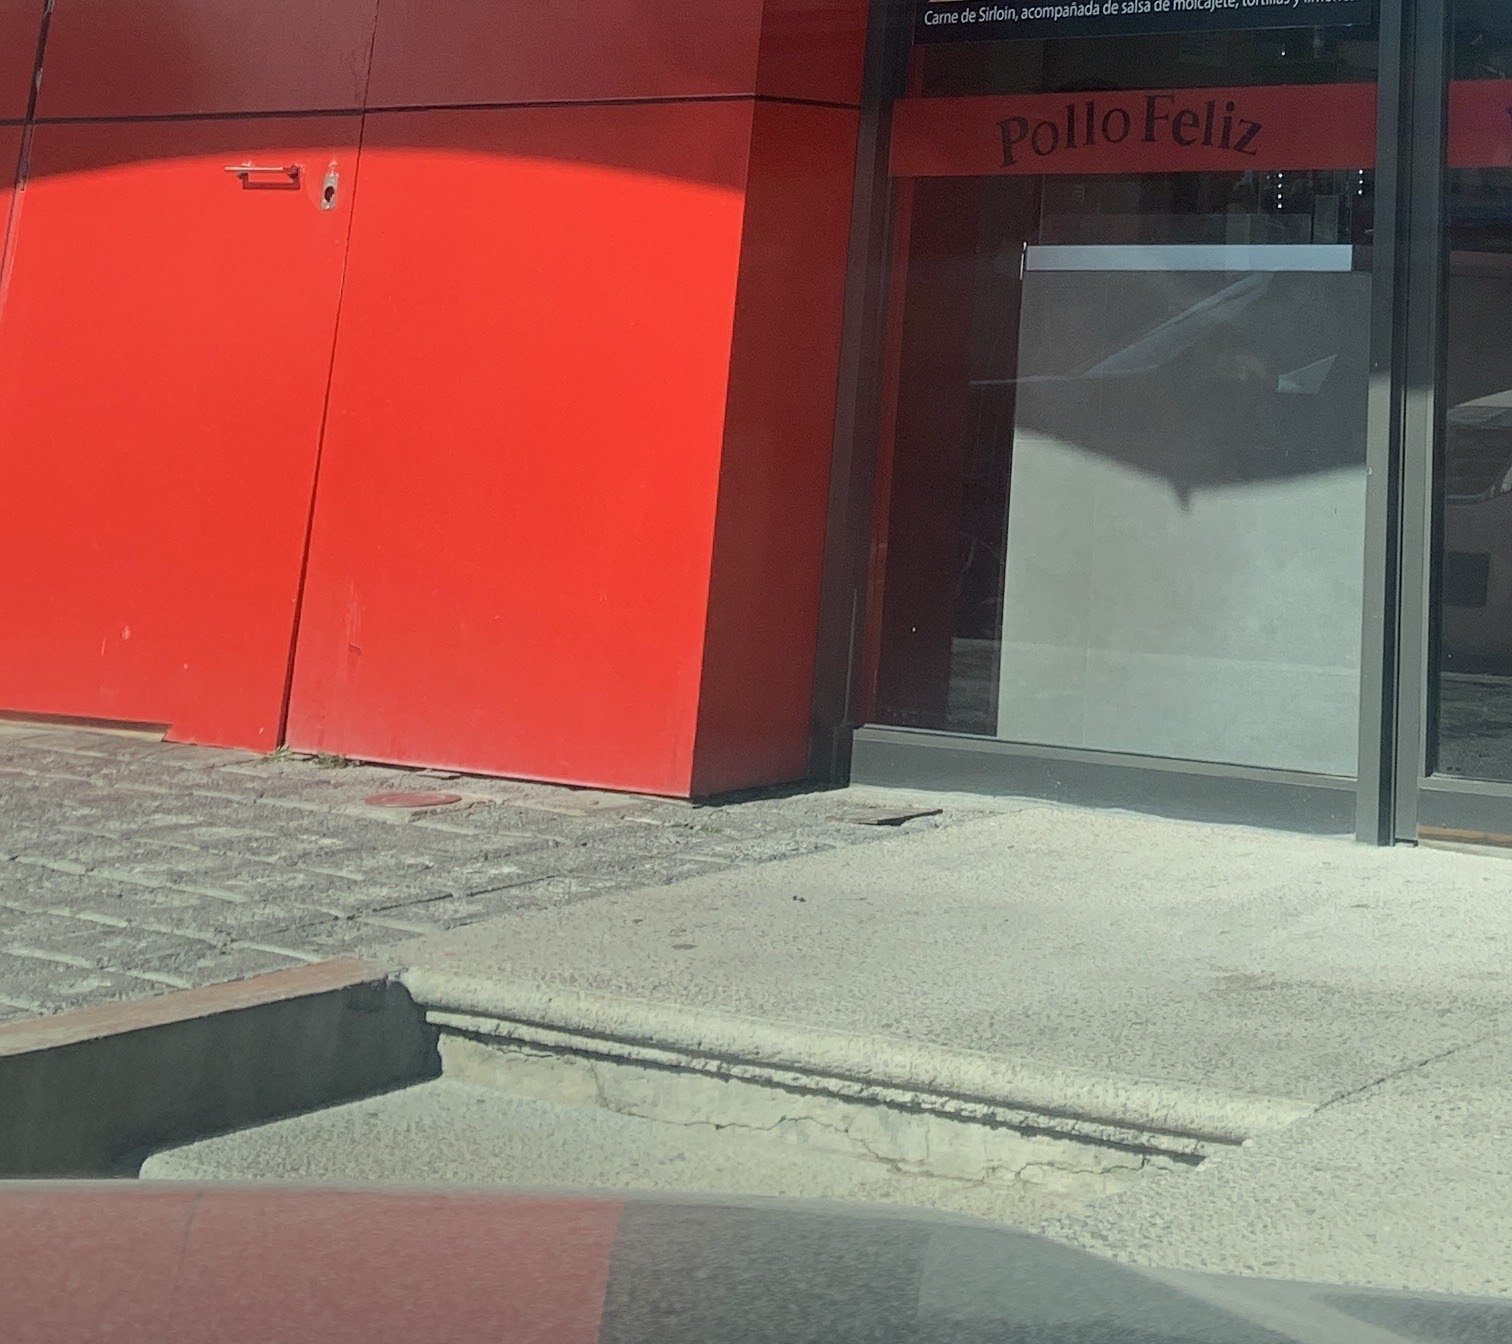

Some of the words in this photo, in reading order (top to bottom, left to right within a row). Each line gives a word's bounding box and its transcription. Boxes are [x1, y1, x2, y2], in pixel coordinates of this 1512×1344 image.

[924, 9, 959, 26] Carne
[961, 8, 976, 23] de
[978, 5, 1019, 22] Sirloin,
[1020, 0, 1100, 21] acompañada
[1102, 0, 1119, 14] de
[996, 99, 1132, 168] Pollo
[1140, 93, 1264, 157] Feliz
